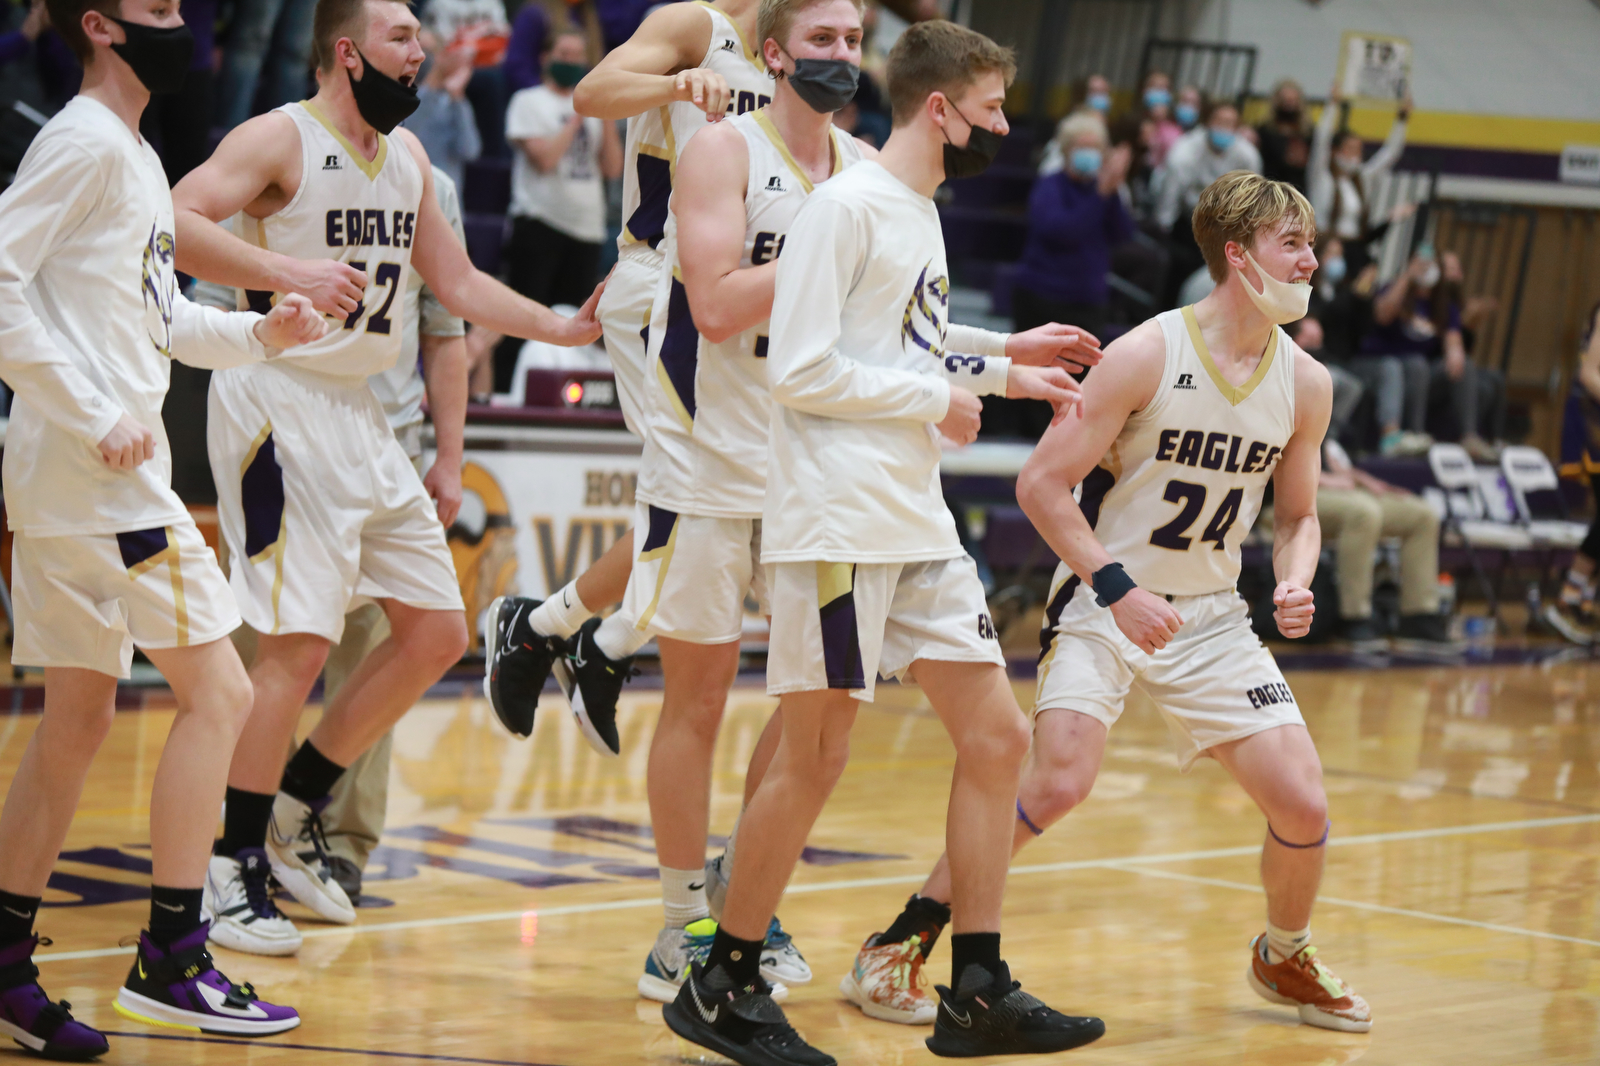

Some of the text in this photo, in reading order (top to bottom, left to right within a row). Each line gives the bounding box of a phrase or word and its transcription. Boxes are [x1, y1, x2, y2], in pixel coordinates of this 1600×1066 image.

[326, 208, 415, 249] EAGLES
[1155, 429, 1281, 474] EAGLES
[1147, 478, 1244, 552] 24
[1246, 682, 1294, 710] EAGLES
